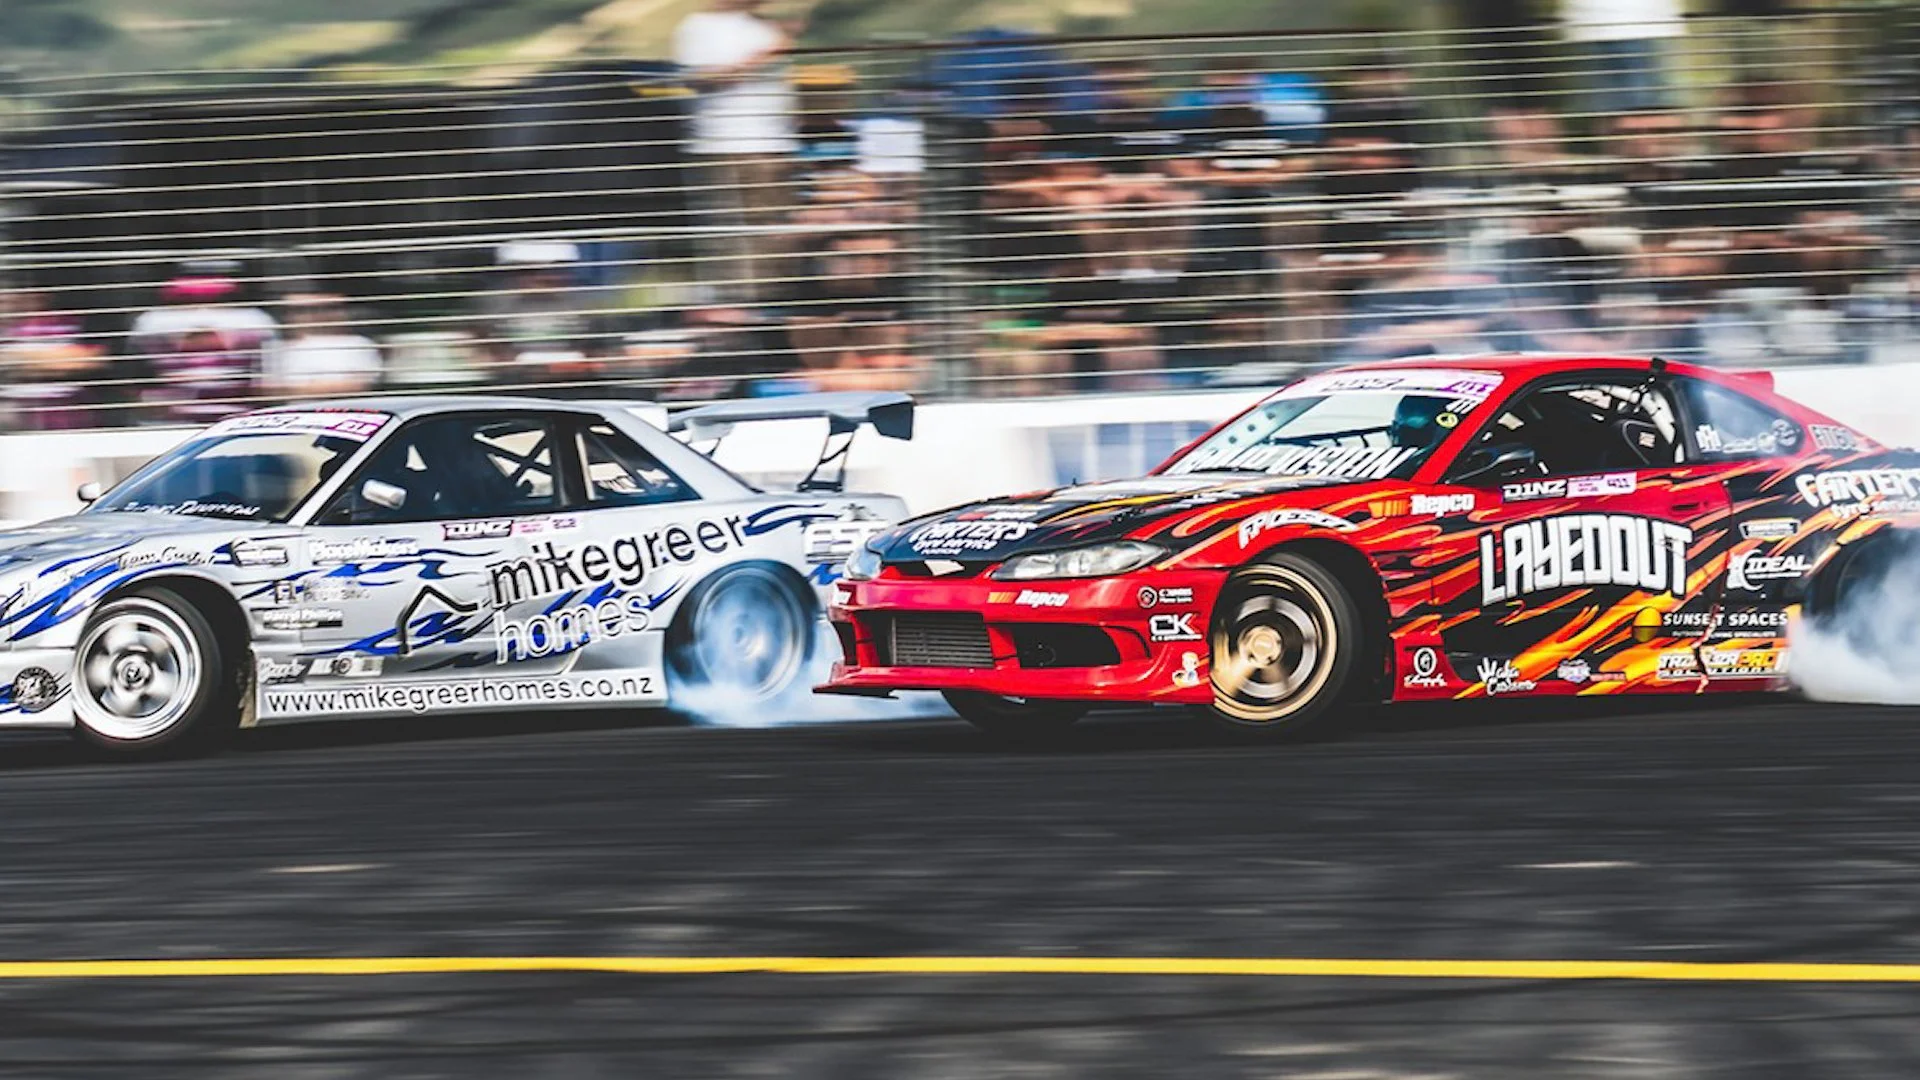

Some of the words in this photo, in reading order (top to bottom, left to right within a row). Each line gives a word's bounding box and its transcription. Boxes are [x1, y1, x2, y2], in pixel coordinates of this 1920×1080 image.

[1502, 480, 1567, 500] D1NZ
[1410, 493, 1474, 517] Repco
[490, 514, 744, 606] mikegreer
[1480, 514, 1693, 606] LAYEDOUT
[1744, 555, 1812, 573] IDEAL
[1015, 589, 1068, 608] Repco
[494, 592, 651, 665] homes
[1728, 612, 1788, 626] SPACES
[267, 676, 653, 711] www.mikegreerhomes.co.nz
